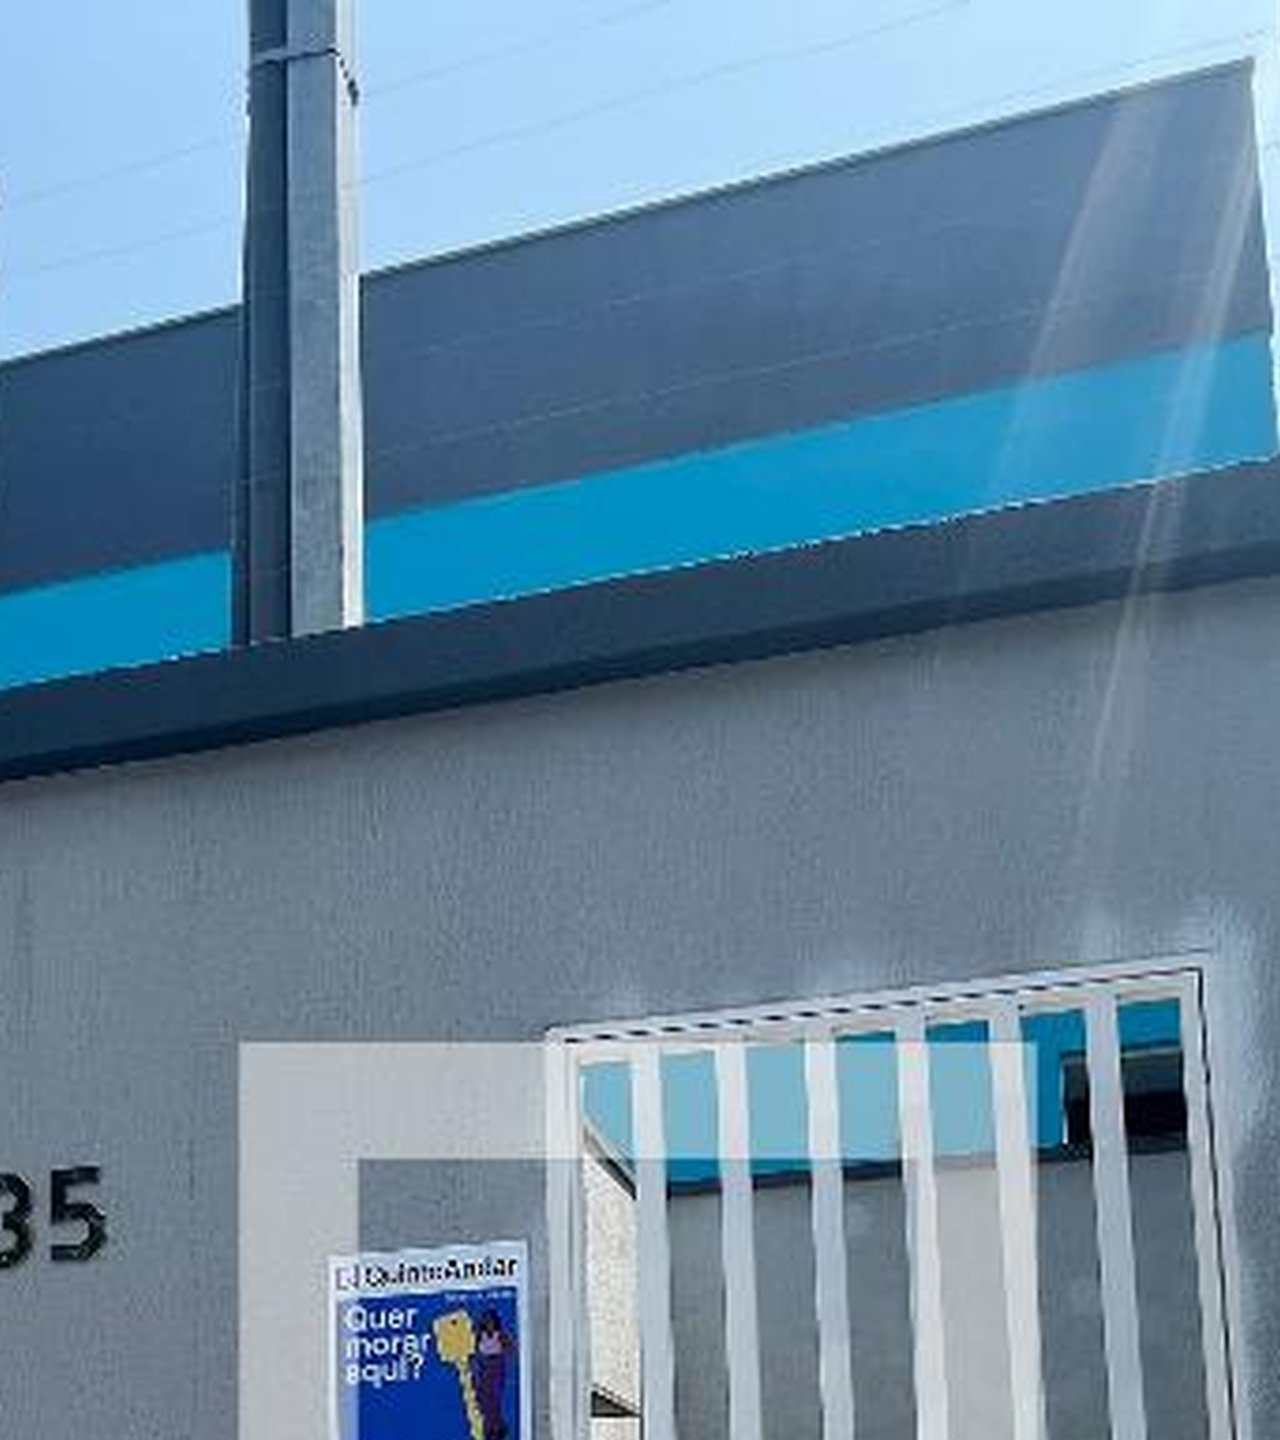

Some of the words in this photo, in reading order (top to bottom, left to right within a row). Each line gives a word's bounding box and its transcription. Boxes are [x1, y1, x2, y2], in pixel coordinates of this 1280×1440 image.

[344, 1304, 419, 1332] Quer
[345, 1332, 431, 1360] morar
[345, 1352, 424, 1388] aqui?
